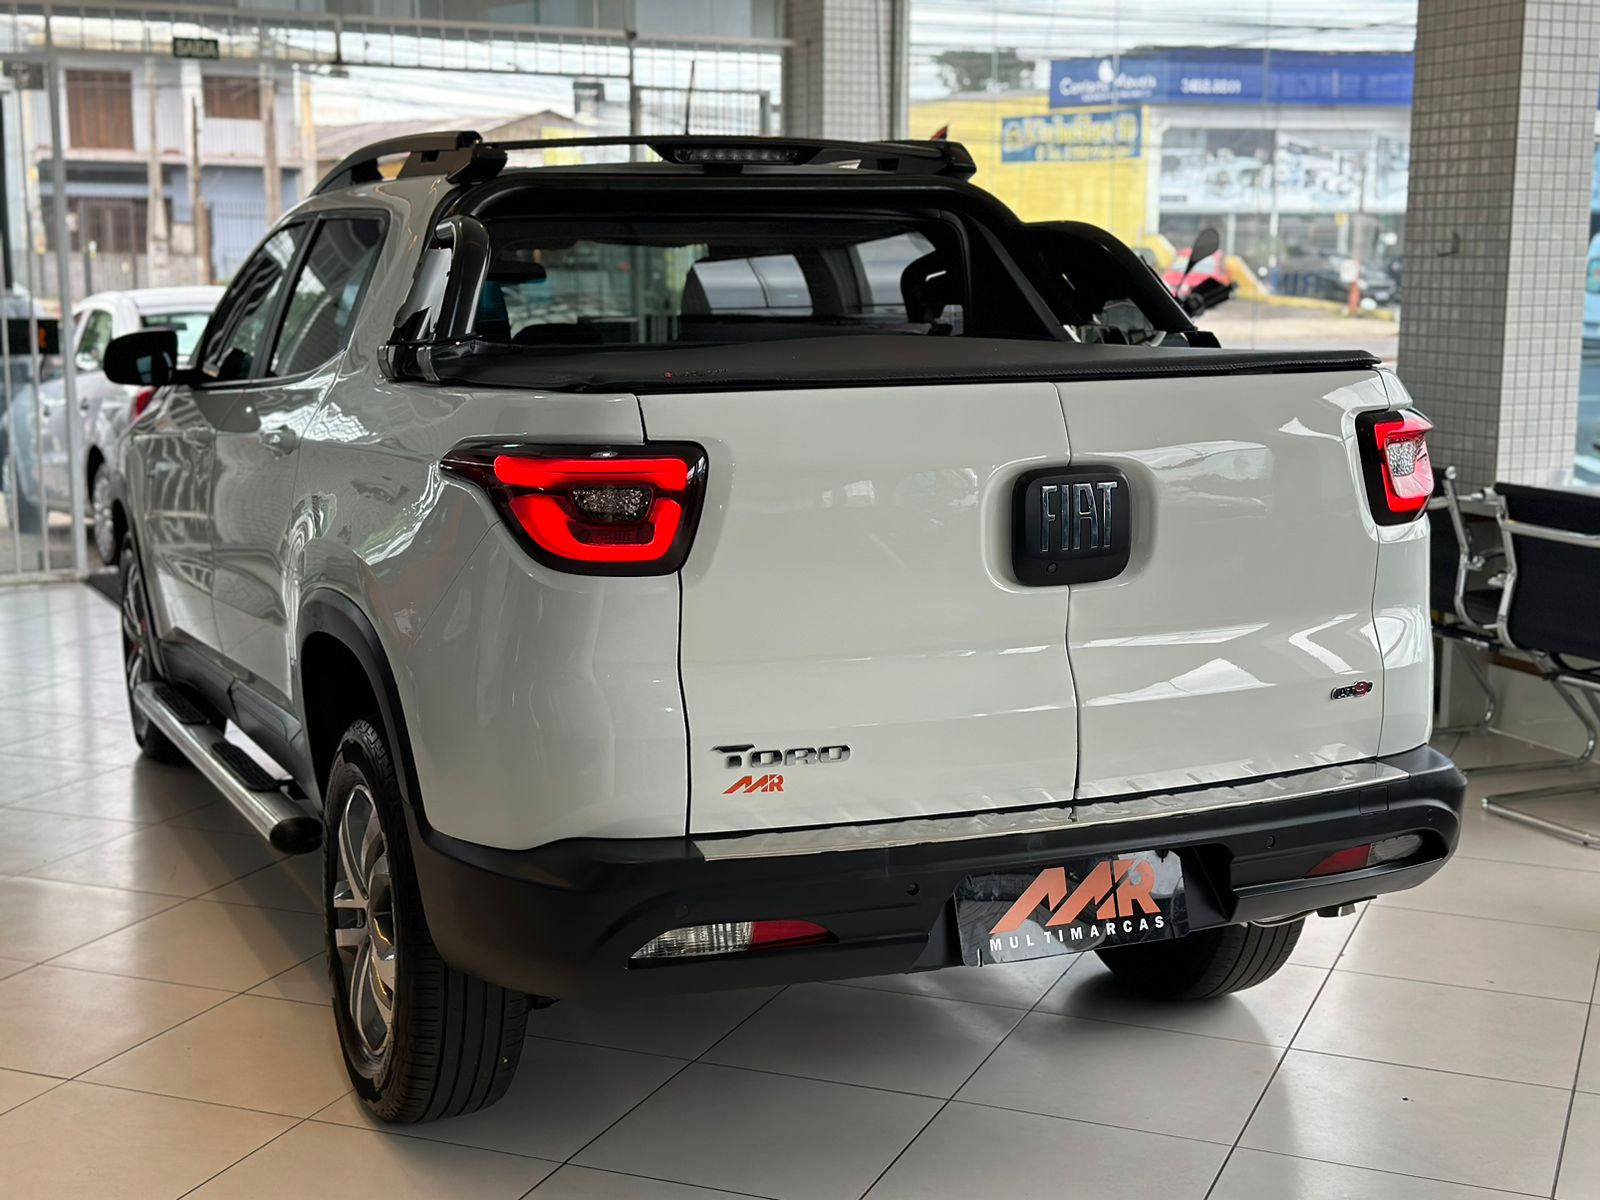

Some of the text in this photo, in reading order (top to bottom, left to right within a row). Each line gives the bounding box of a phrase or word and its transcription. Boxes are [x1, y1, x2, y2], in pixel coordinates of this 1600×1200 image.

[1041, 481, 1118, 552] FIAT
[709, 743, 852, 769] TORO
[989, 915, 1165, 952] MULTIMARCAS
